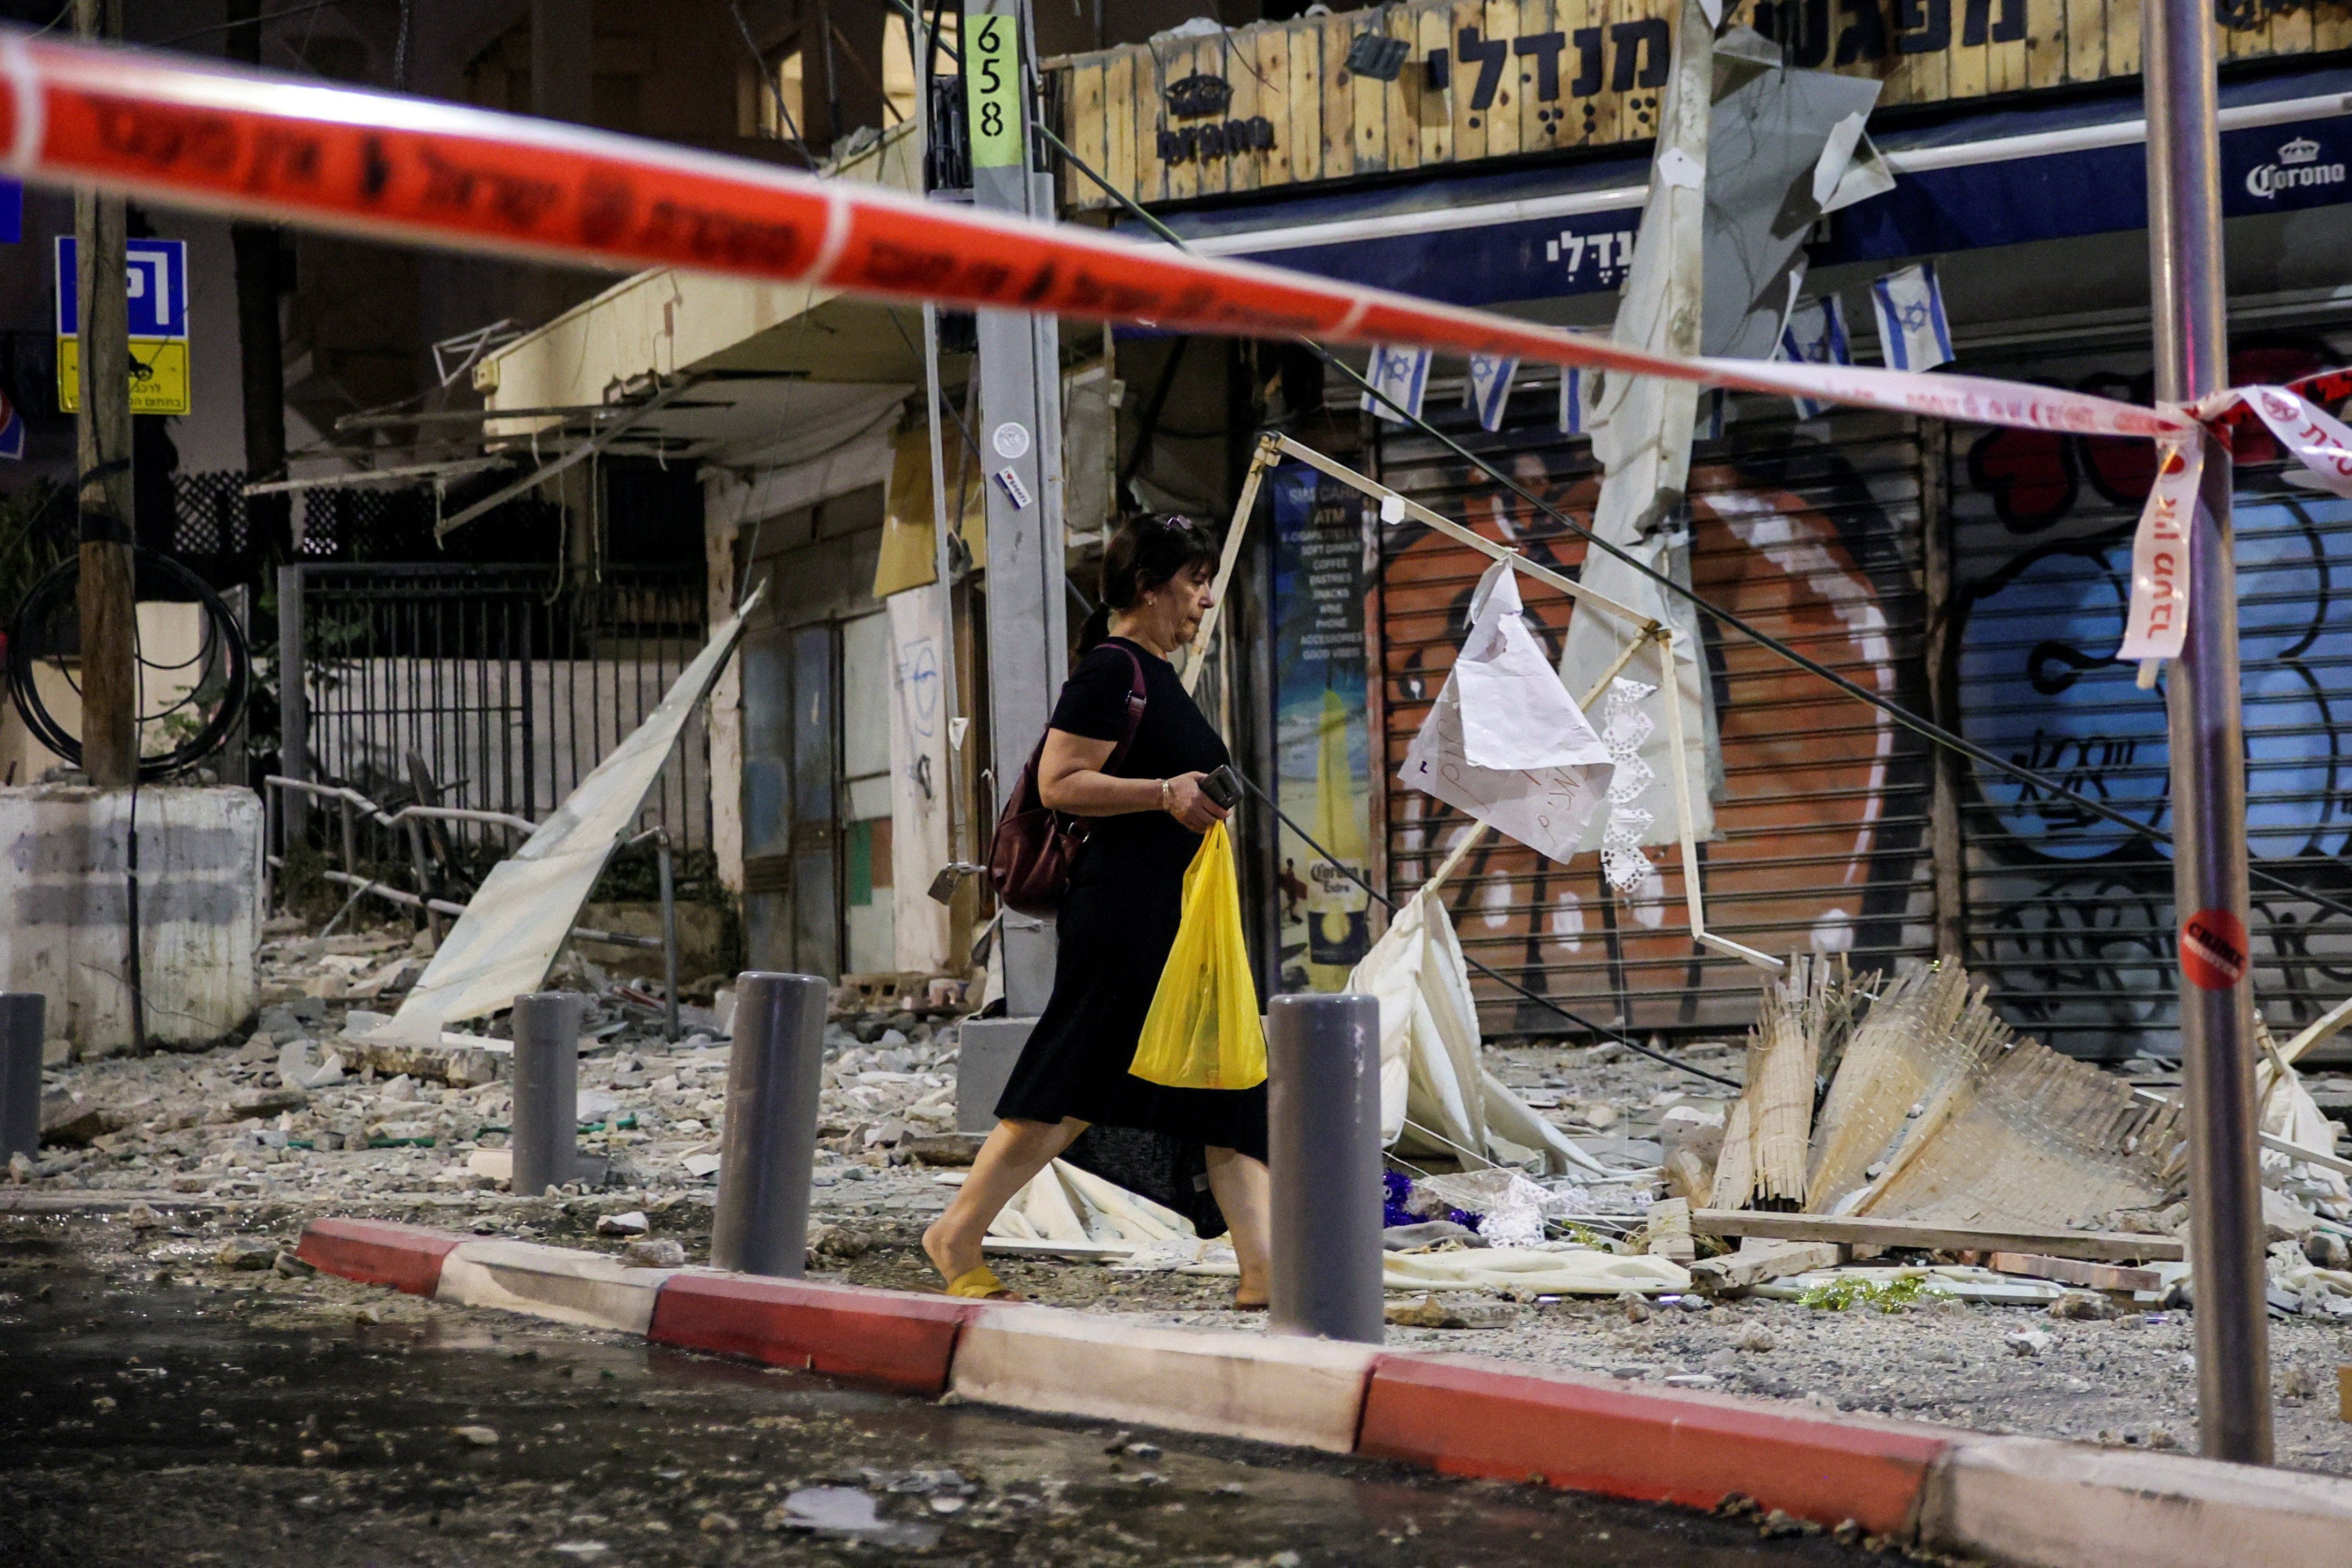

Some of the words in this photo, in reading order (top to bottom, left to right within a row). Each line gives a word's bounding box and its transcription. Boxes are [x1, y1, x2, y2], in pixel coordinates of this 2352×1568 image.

[2246, 163, 2345, 199] Corona
[1290, 486, 1316, 504] SIM
[1315, 508, 1345, 524] ATM
[1313, 558, 1347, 570] COFFEE
[2147, 553, 2174, 639] מעבר
